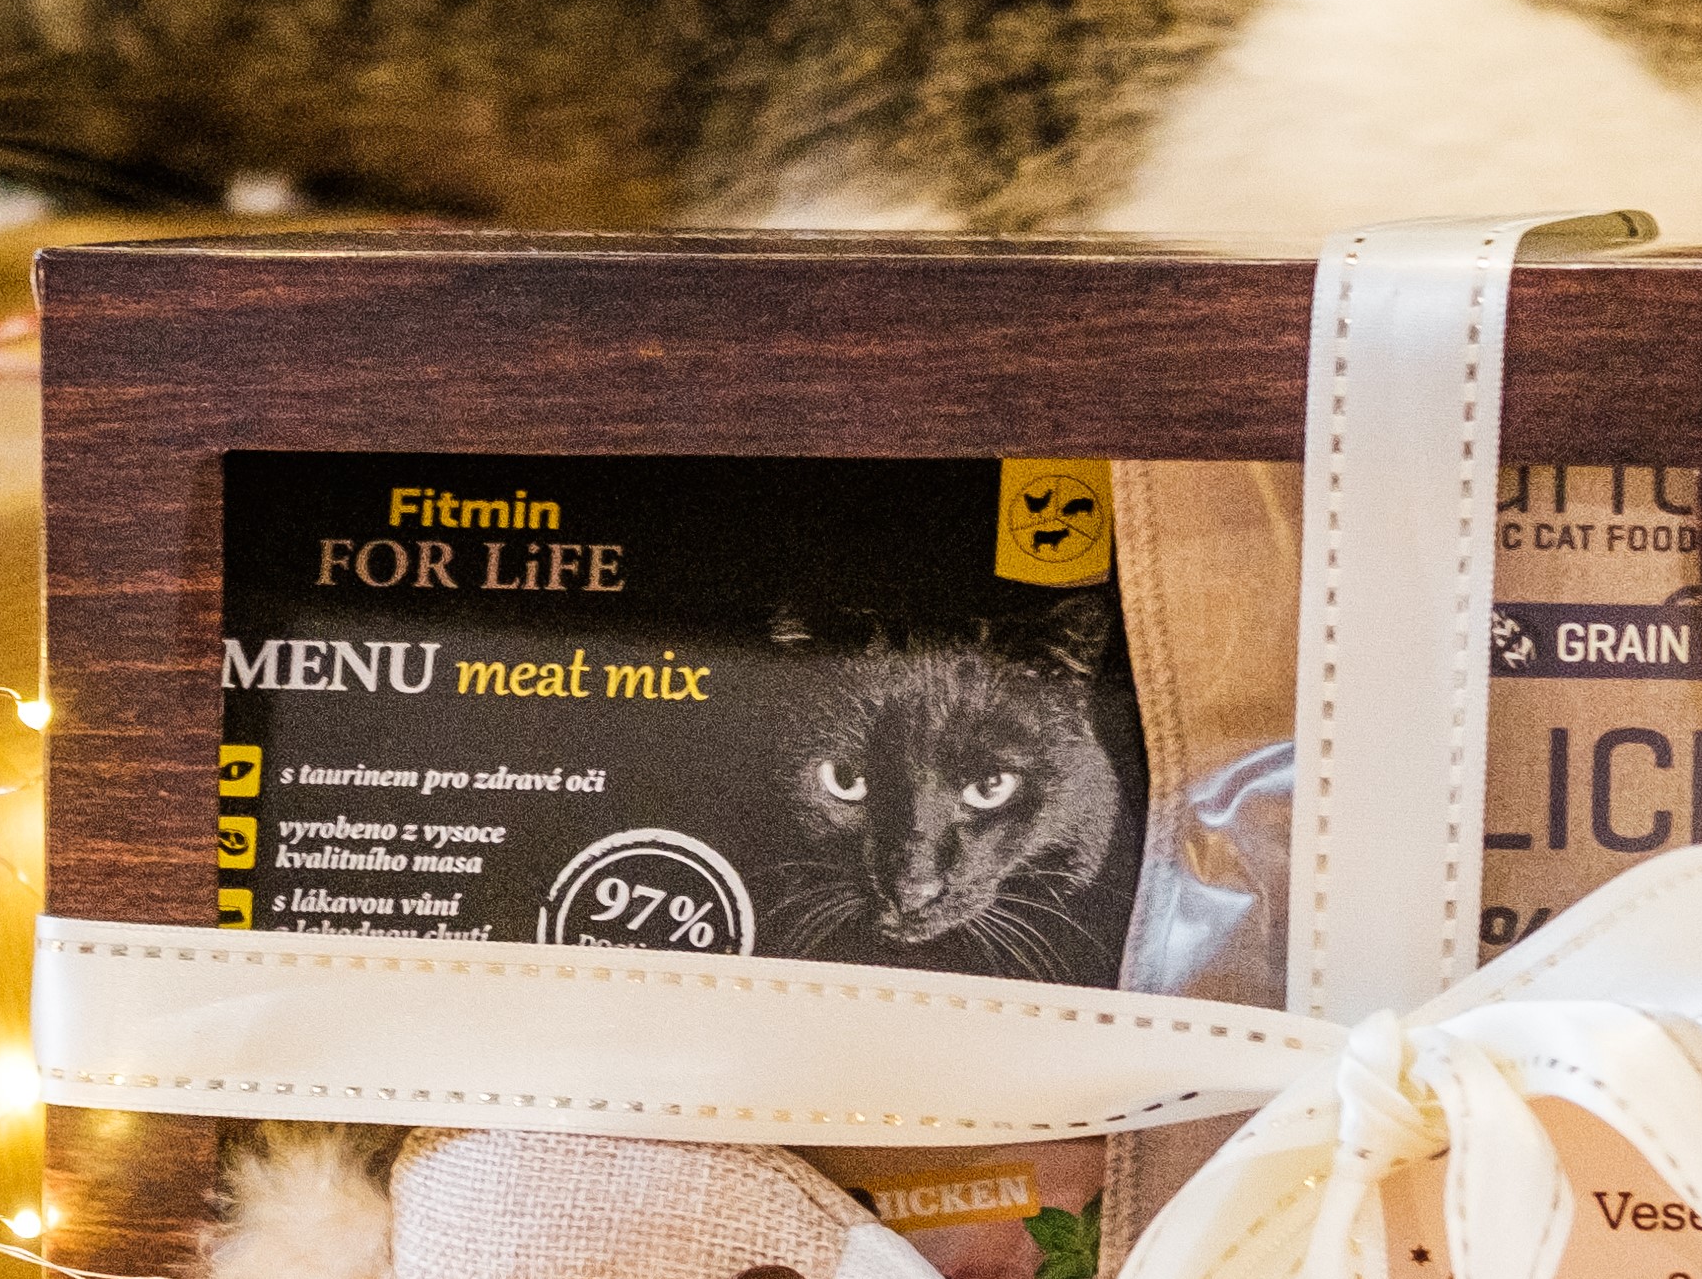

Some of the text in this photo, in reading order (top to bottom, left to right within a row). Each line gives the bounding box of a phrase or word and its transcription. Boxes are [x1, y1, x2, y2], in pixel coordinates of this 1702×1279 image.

[389, 487, 561, 530] Fitmin
[1533, 522, 1595, 551] CAT
[1607, 524, 1698, 553] FOOD
[316, 540, 458, 589] FOR
[1556, 622, 1691, 665] GRAIN
[222, 639, 711, 701] MENU meat mix
[280, 764, 606, 795] s taurinem pro zdravé oči
[279, 815, 507, 849] vyrobeno z vysoce
[275, 844, 484, 873] kvalitního masa
[272, 888, 463, 917] s lákavou vůní
[590, 877, 714, 948] 97%
